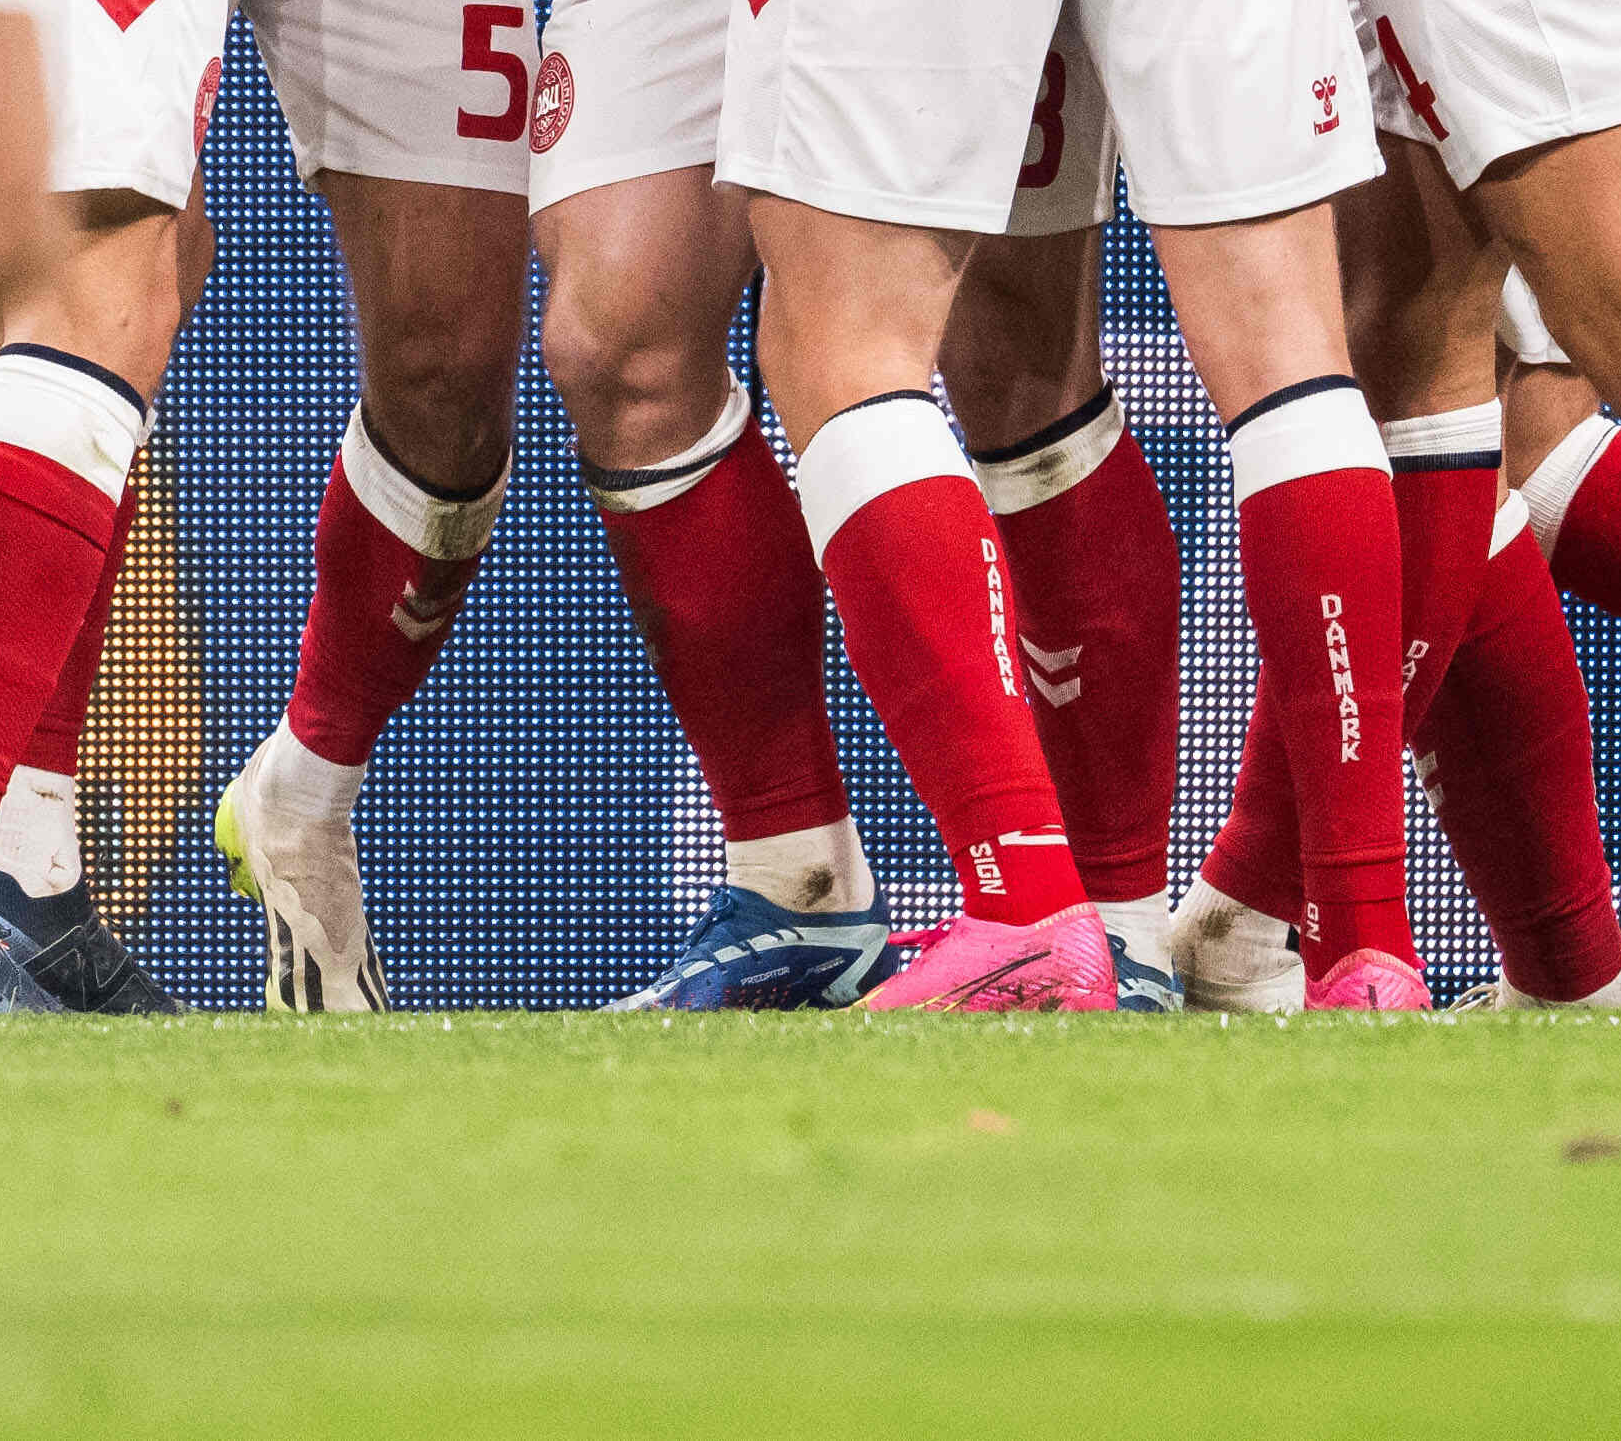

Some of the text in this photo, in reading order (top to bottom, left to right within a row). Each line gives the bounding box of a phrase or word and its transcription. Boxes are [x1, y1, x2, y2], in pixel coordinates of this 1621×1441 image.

[457, 3, 529, 142] 5
[980, 537, 1019, 697] DANMARK
[1320, 593, 1361, 763] DANMARK
